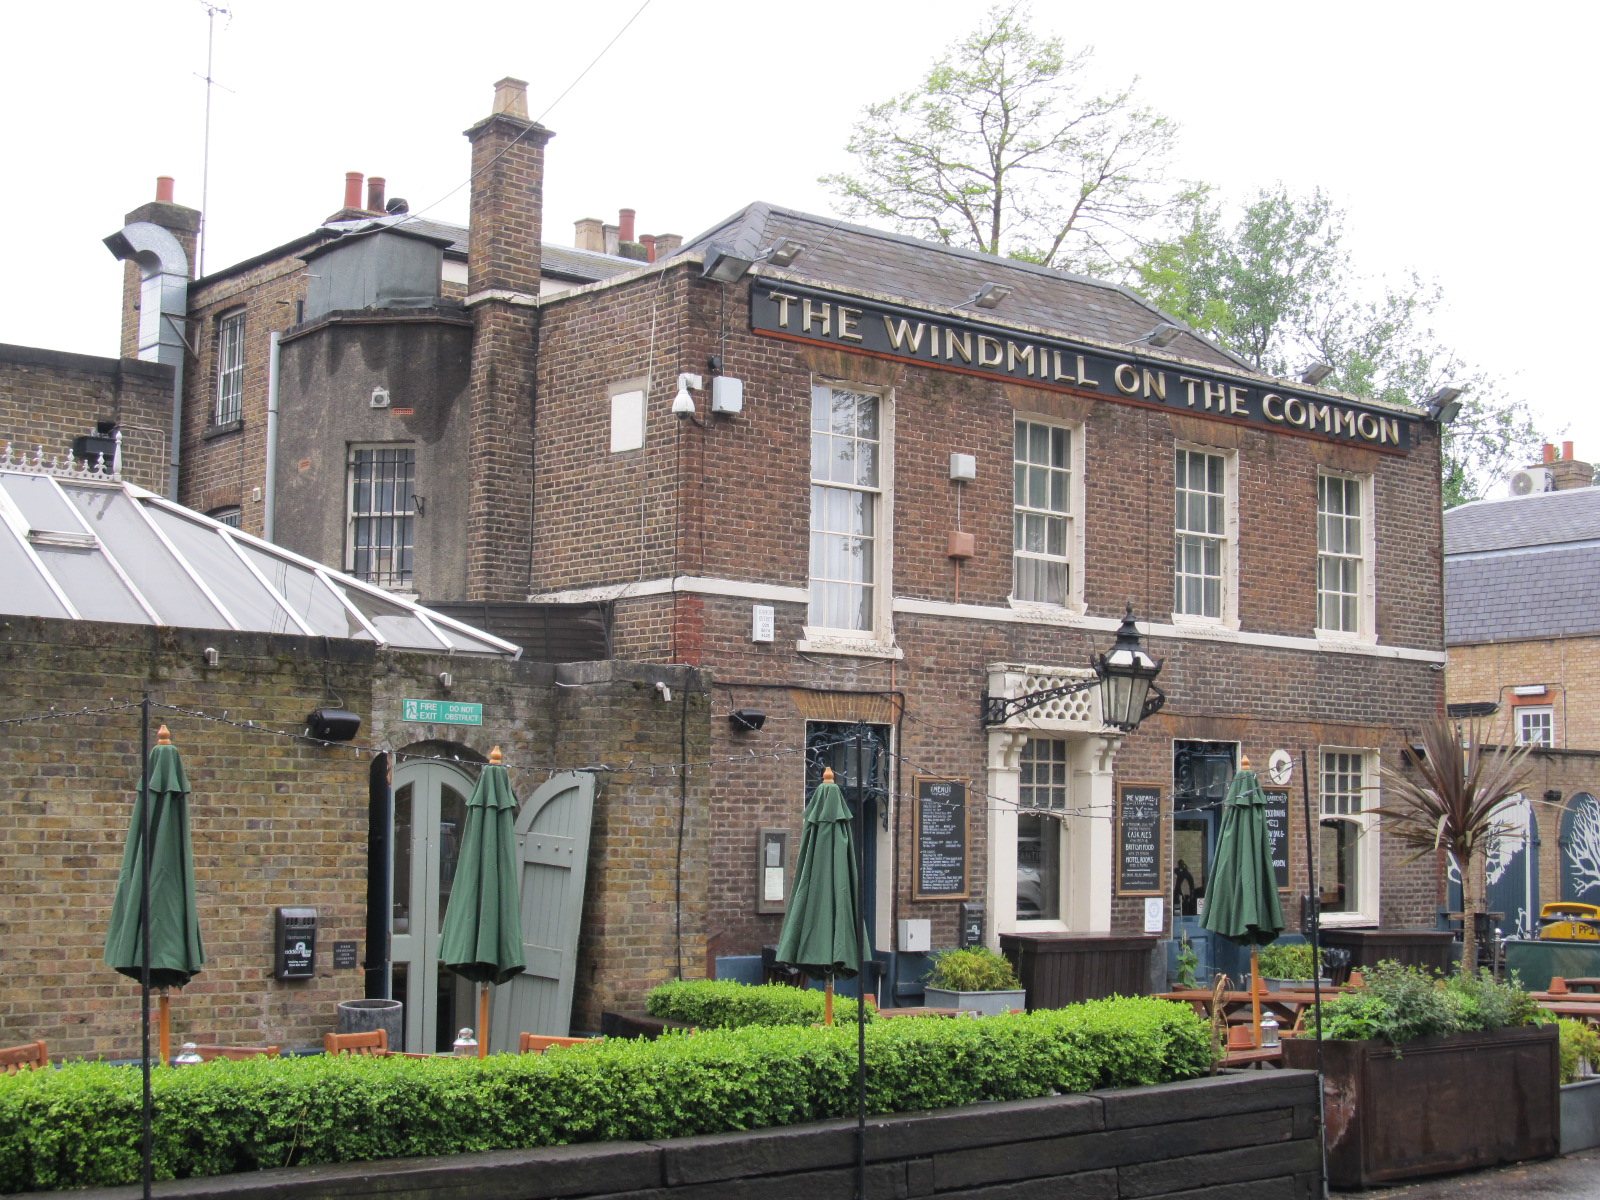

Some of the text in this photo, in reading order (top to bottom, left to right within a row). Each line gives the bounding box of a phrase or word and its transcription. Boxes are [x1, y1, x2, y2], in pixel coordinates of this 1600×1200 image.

[769, 291, 1400, 447] THE WINDMILL ON THE COMMON
[420, 712, 437, 720] EXIT
[444, 713, 478, 722] OBSTRUCT
[933, 786, 949, 794] MENU
